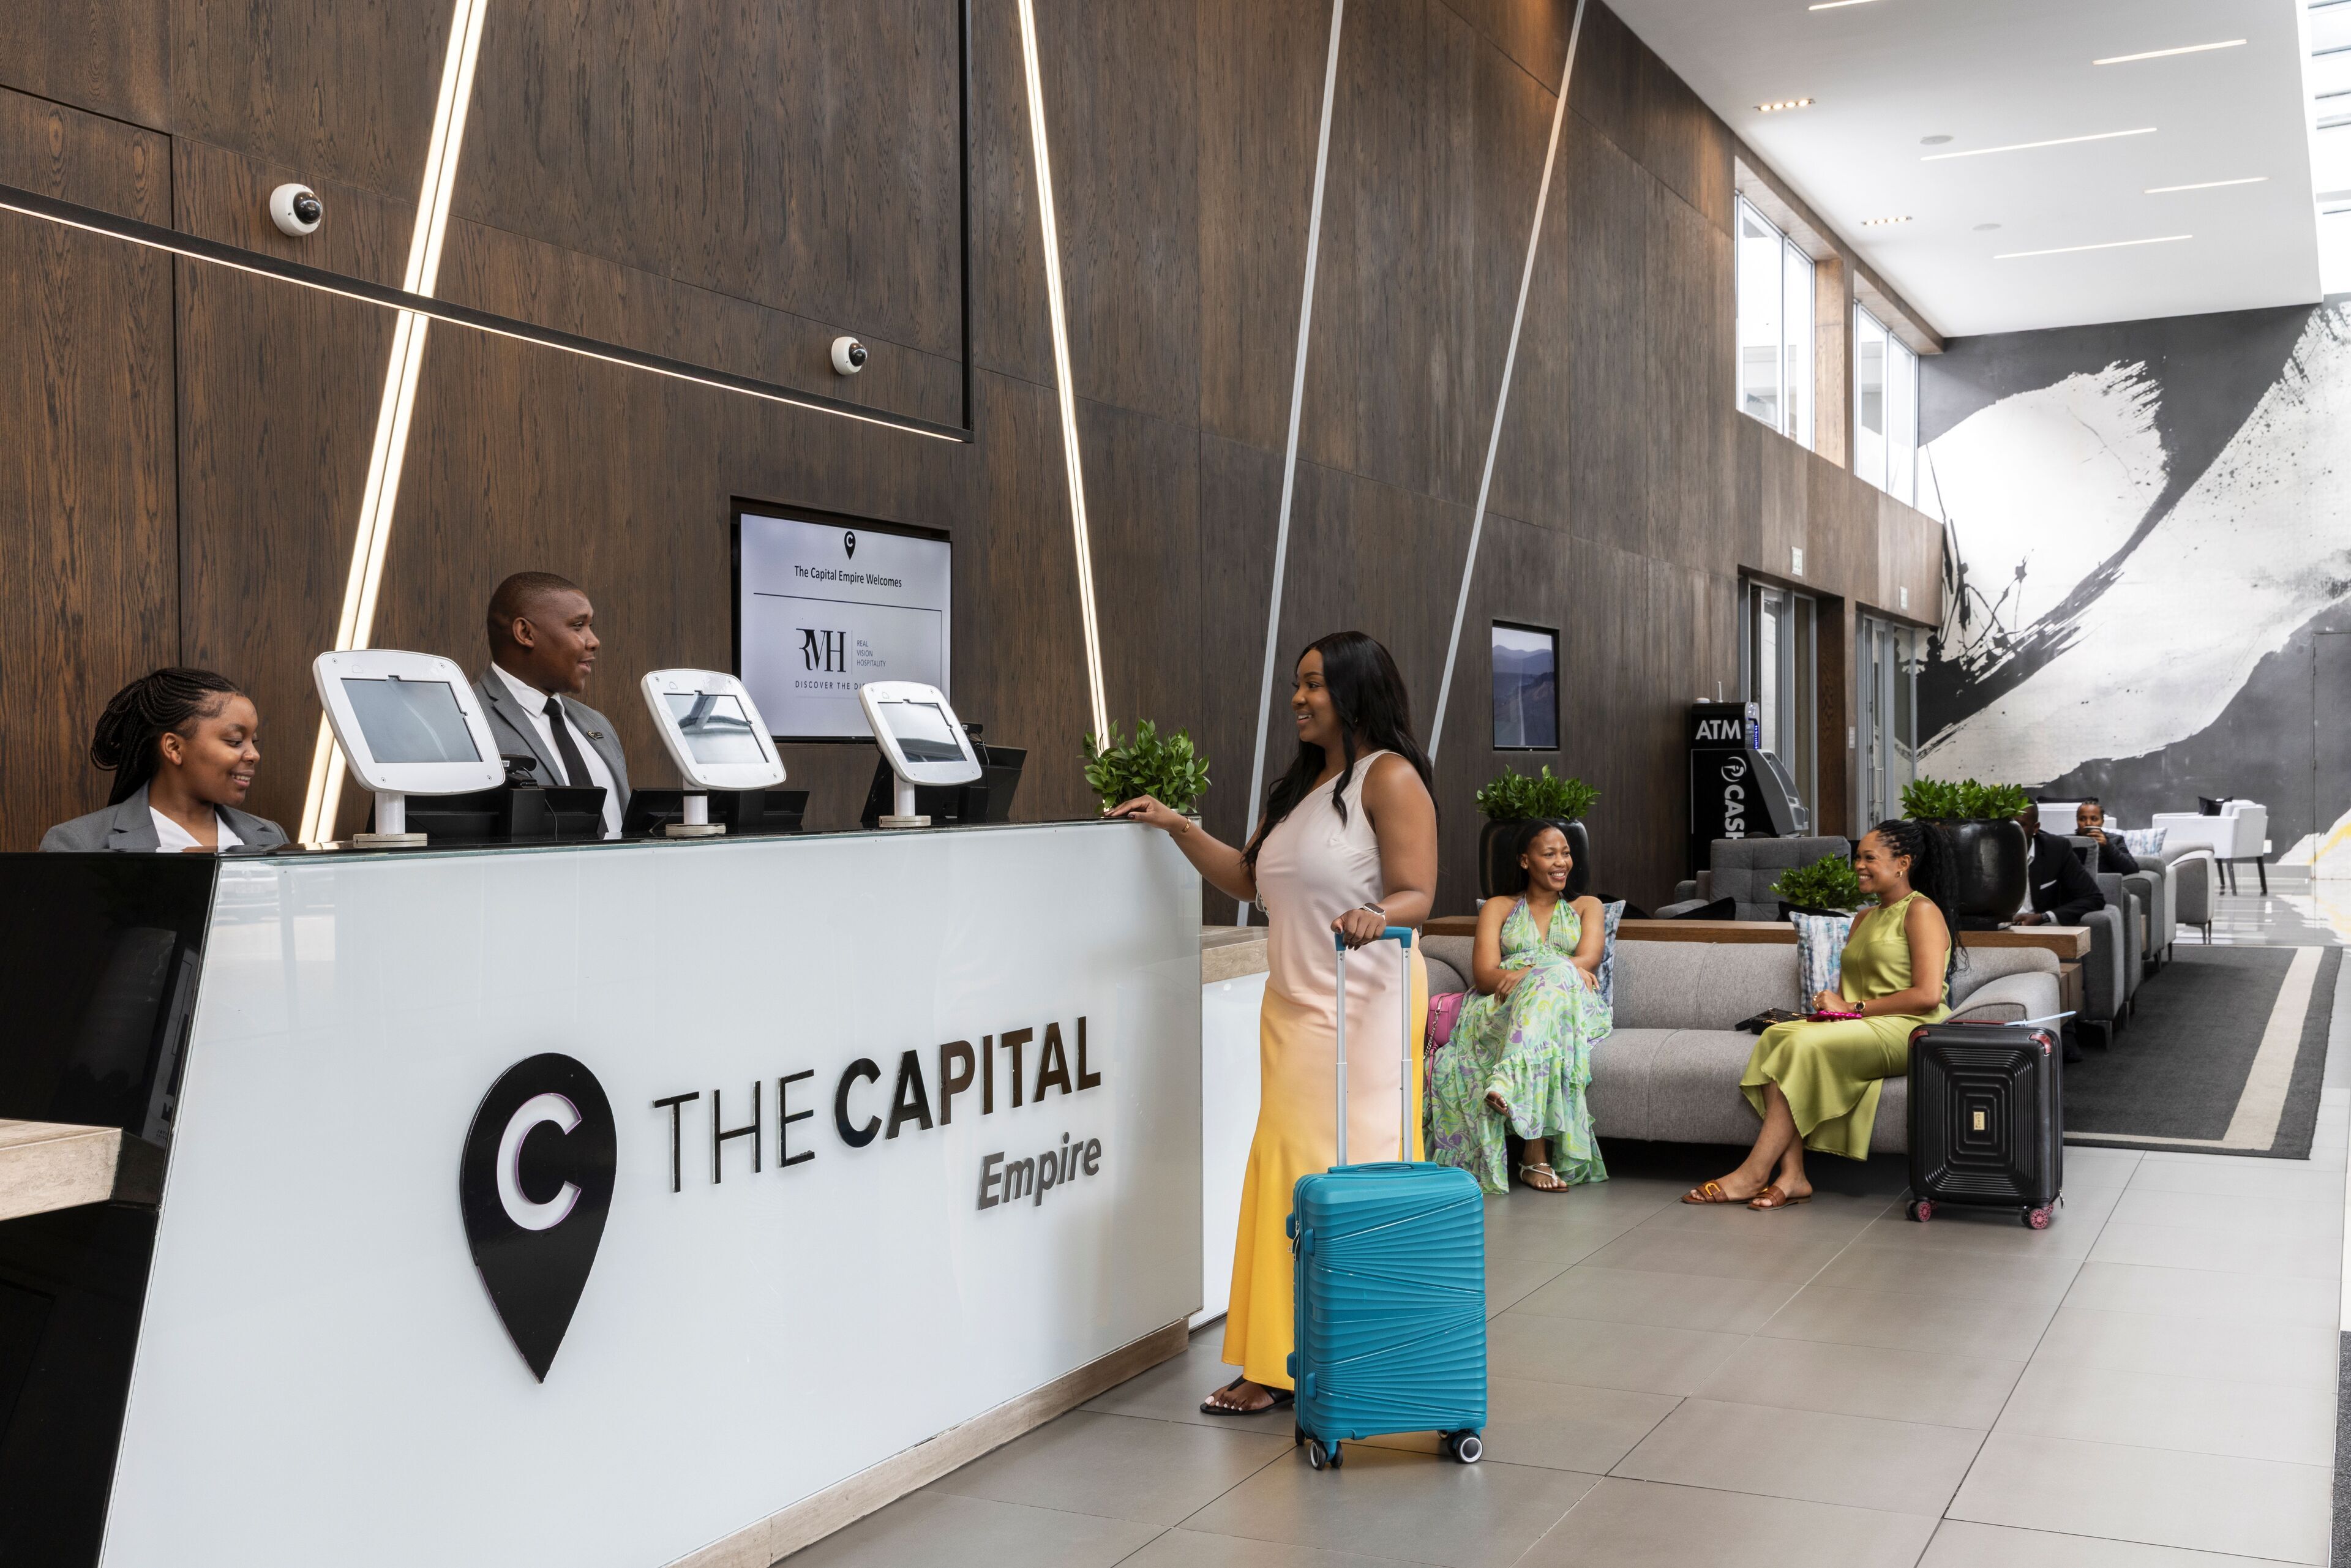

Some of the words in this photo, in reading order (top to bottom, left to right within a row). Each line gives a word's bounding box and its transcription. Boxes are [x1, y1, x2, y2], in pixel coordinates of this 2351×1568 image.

[794, 565, 809, 577] The
[811, 567, 837, 582] Capital
[839, 570, 864, 585] Empire
[866, 573, 902, 588] Welcomes
[796, 628, 847, 673] RVH
[857, 659, 887, 667] HOSPITALITY
[795, 680, 833, 689] DISCOVER
[1695, 719, 1741, 740] ATM
[653, 1069, 816, 1193] THE
[834, 1016, 1101, 1148] CAPITAL
[497, 1093, 582, 1231] C
[977, 1131, 1102, 1210] Empire
